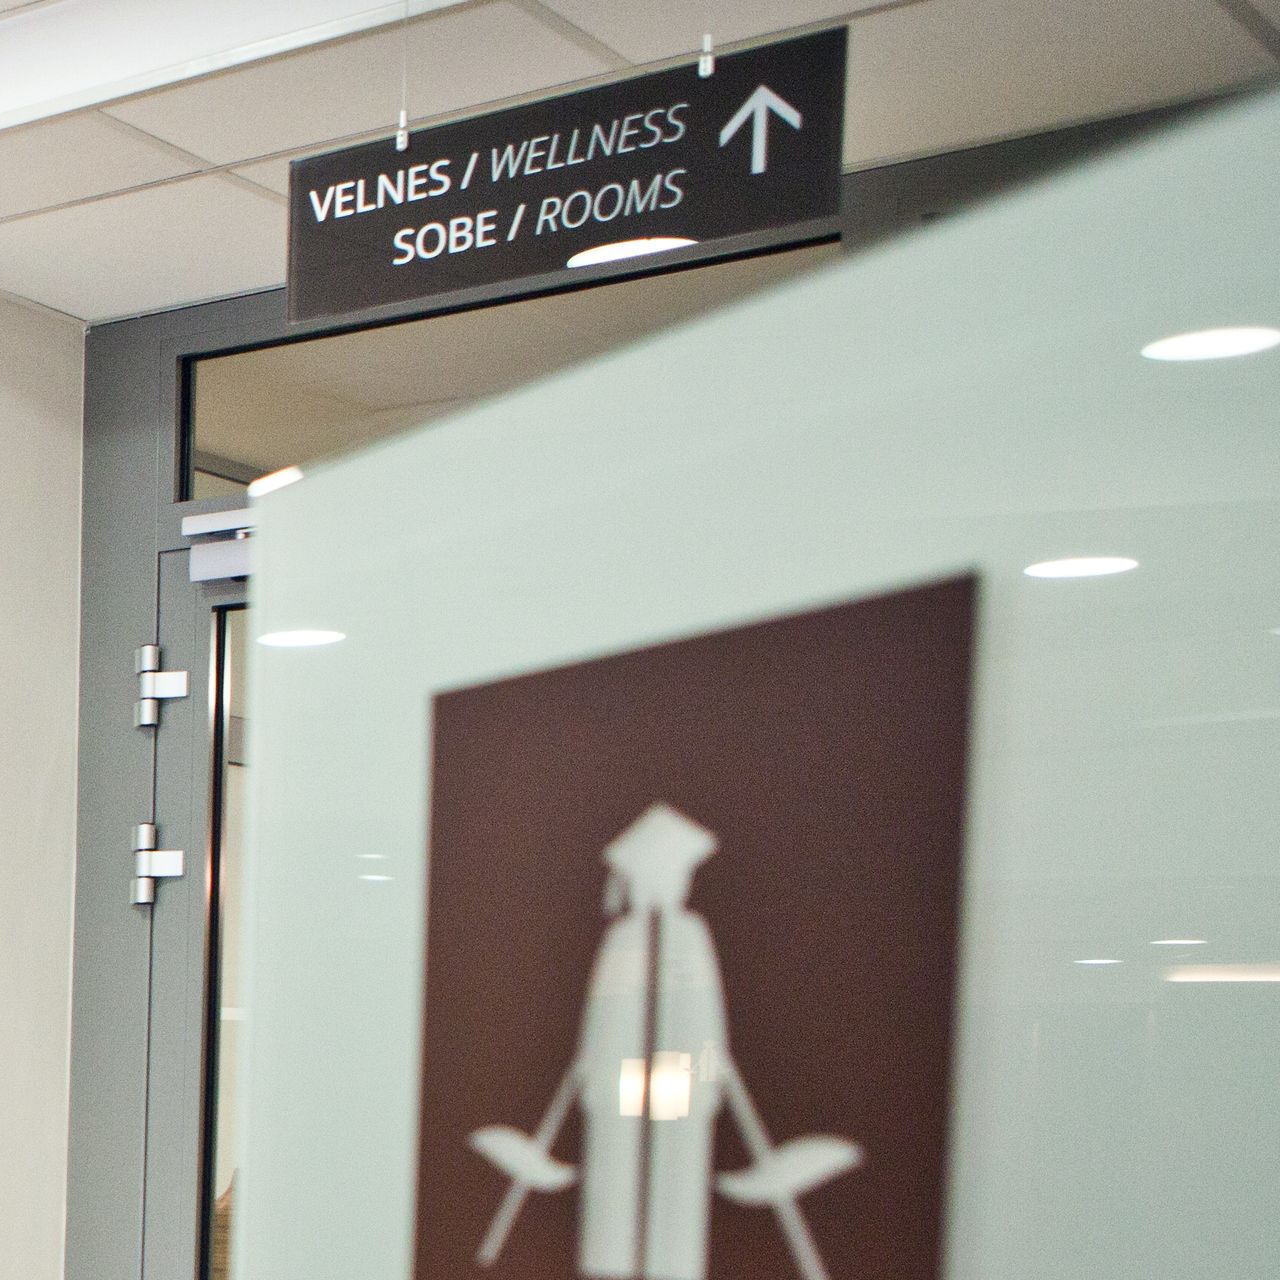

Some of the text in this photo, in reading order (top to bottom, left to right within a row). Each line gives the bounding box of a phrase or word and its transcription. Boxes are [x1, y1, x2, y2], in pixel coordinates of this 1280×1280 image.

[309, 103, 689, 223] VELNES / WELLNESS
[391, 168, 688, 267] SOBE / ROOMS
